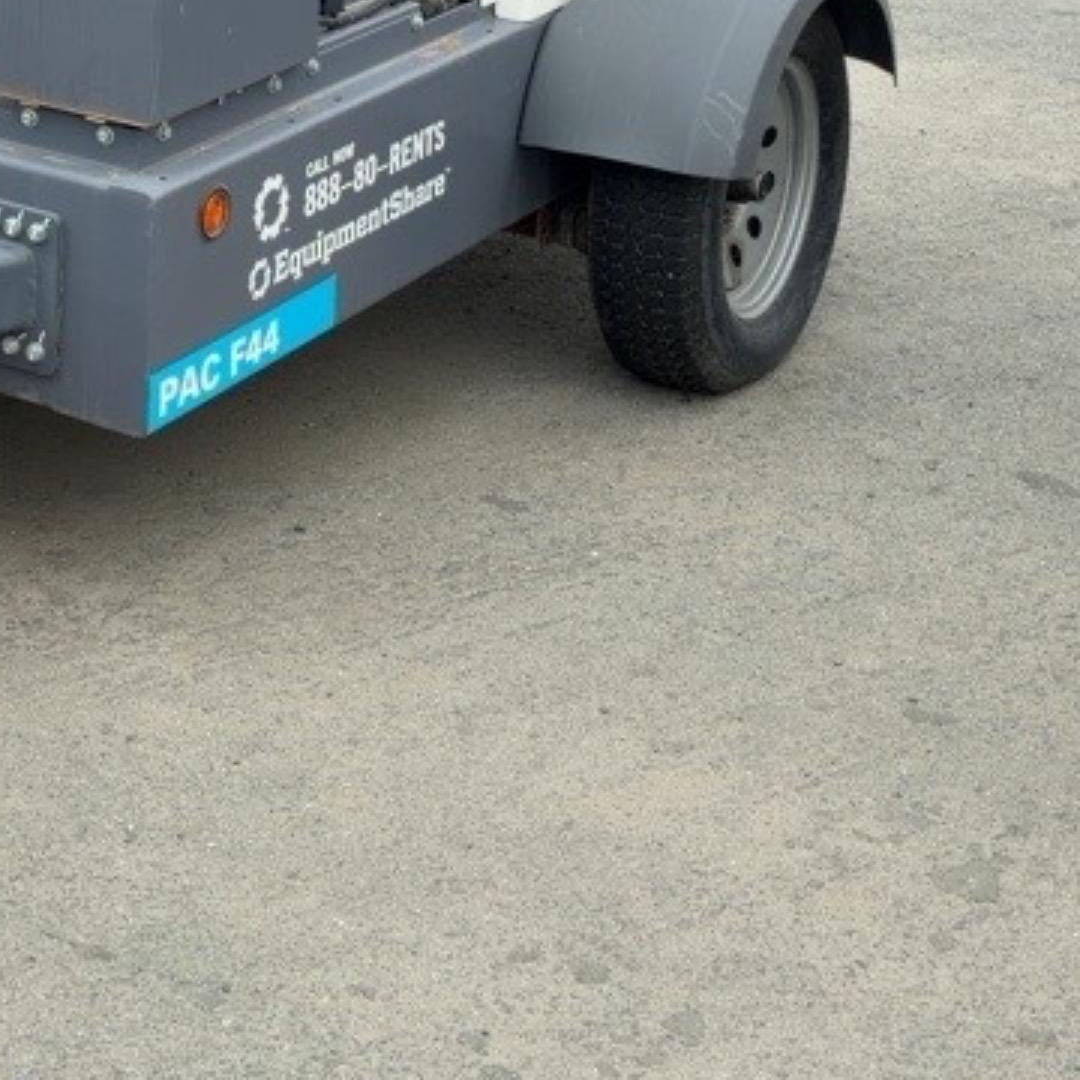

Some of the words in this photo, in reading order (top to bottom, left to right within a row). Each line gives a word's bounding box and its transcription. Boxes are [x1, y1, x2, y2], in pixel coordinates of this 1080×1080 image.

[304, 120, 446, 217] 888-80-RENTS
[306, 155, 330, 178] CALL
[273, 173, 447, 282] EquipmentShare
[159, 353, 222, 418] PAC
[230, 319, 281, 377] F44
